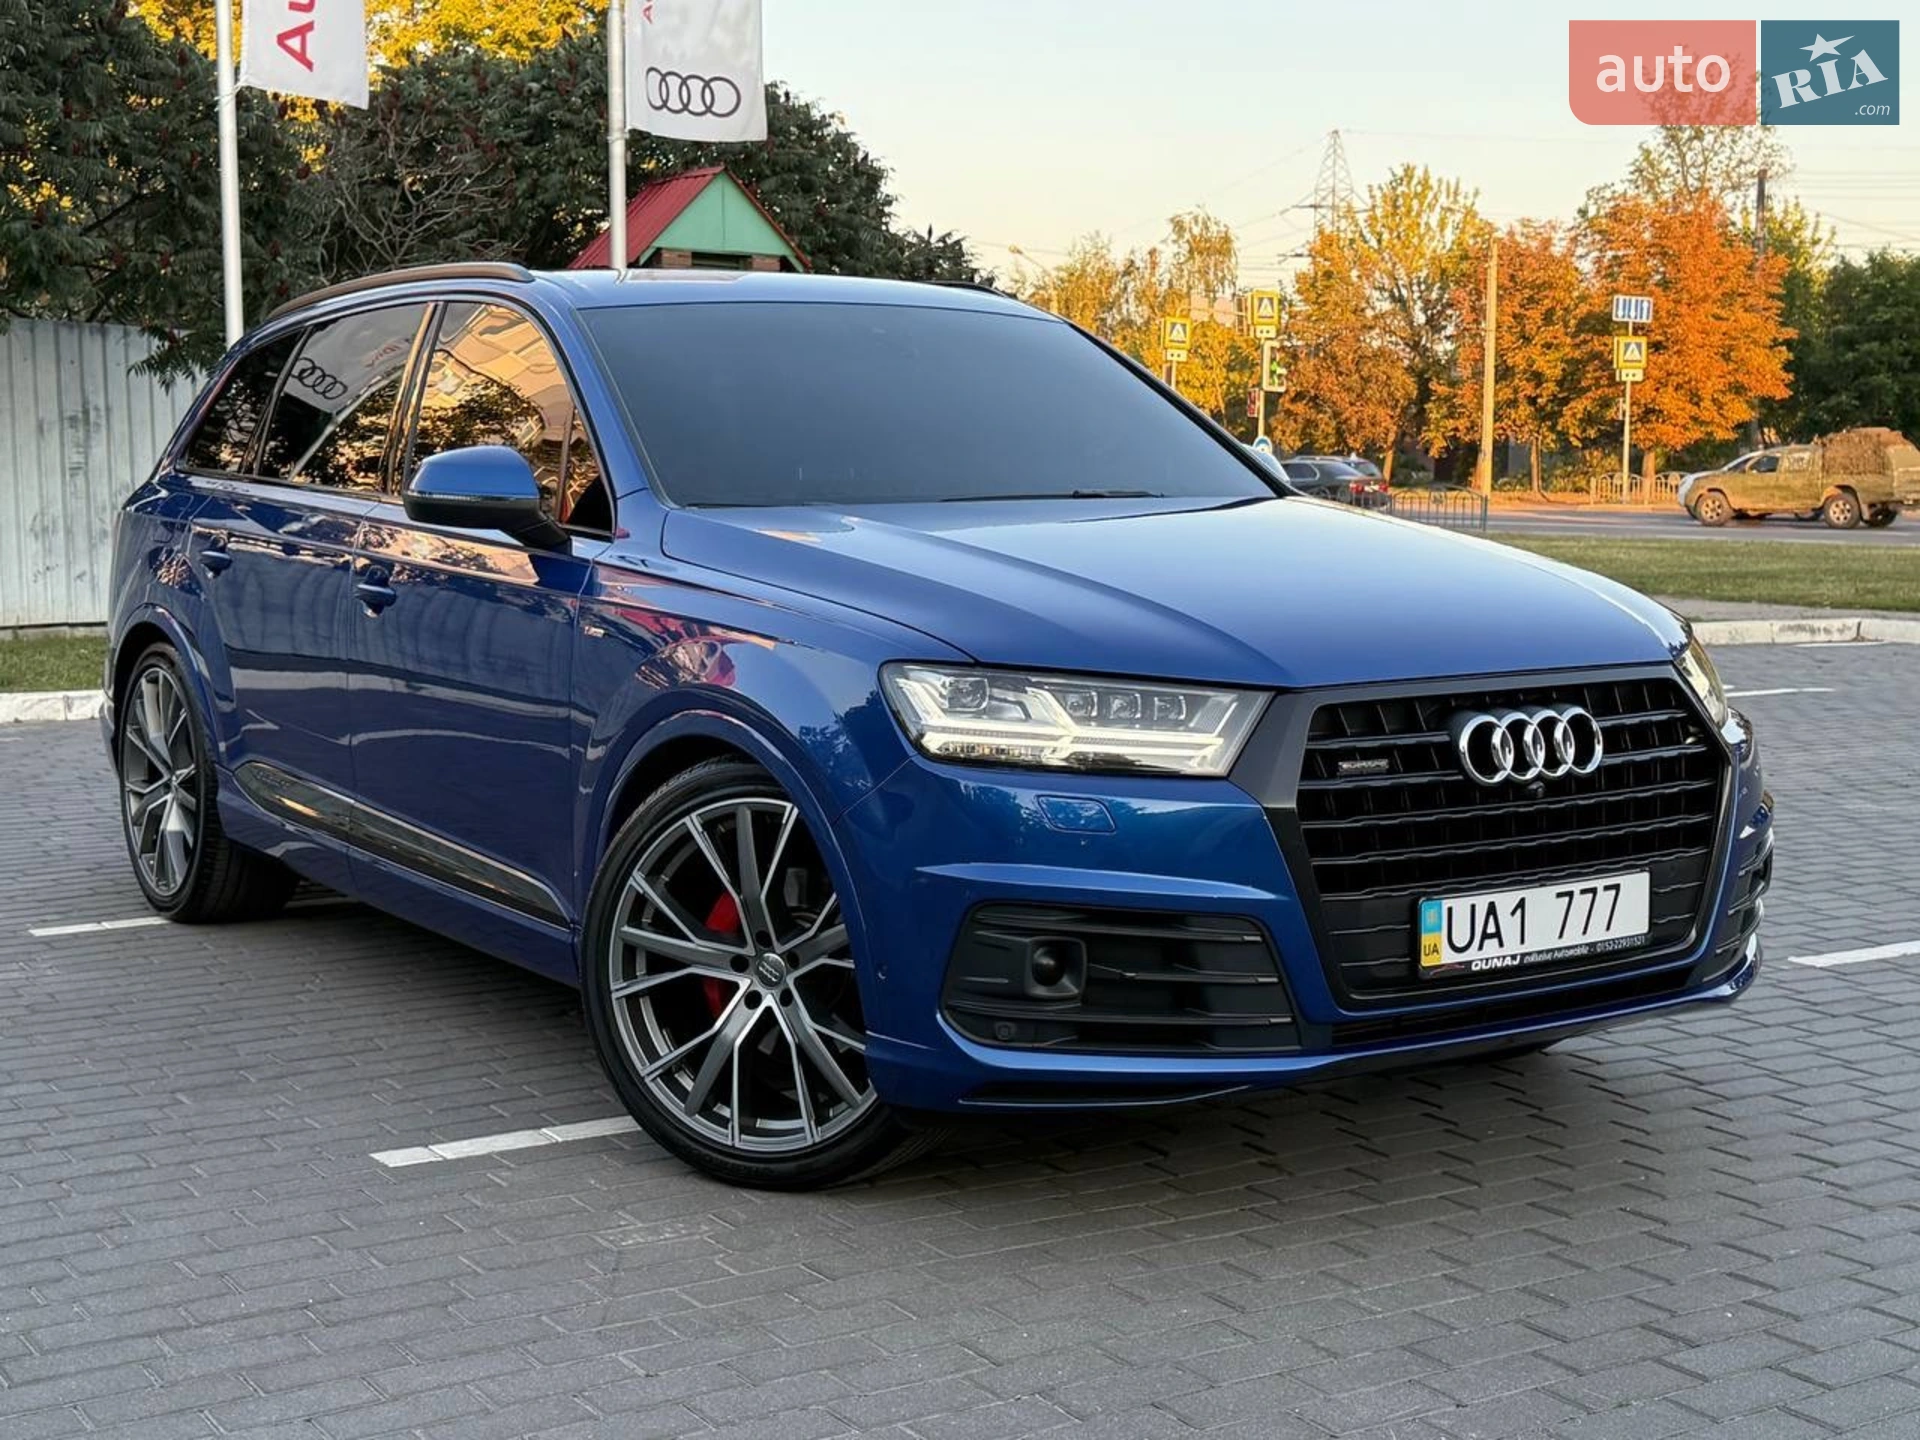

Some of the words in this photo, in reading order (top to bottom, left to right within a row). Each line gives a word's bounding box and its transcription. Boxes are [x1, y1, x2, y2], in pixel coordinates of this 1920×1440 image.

[1446, 896, 1527, 954] UA1
[1555, 882, 1621, 940] 777
[1423, 943, 1440, 957] UA
